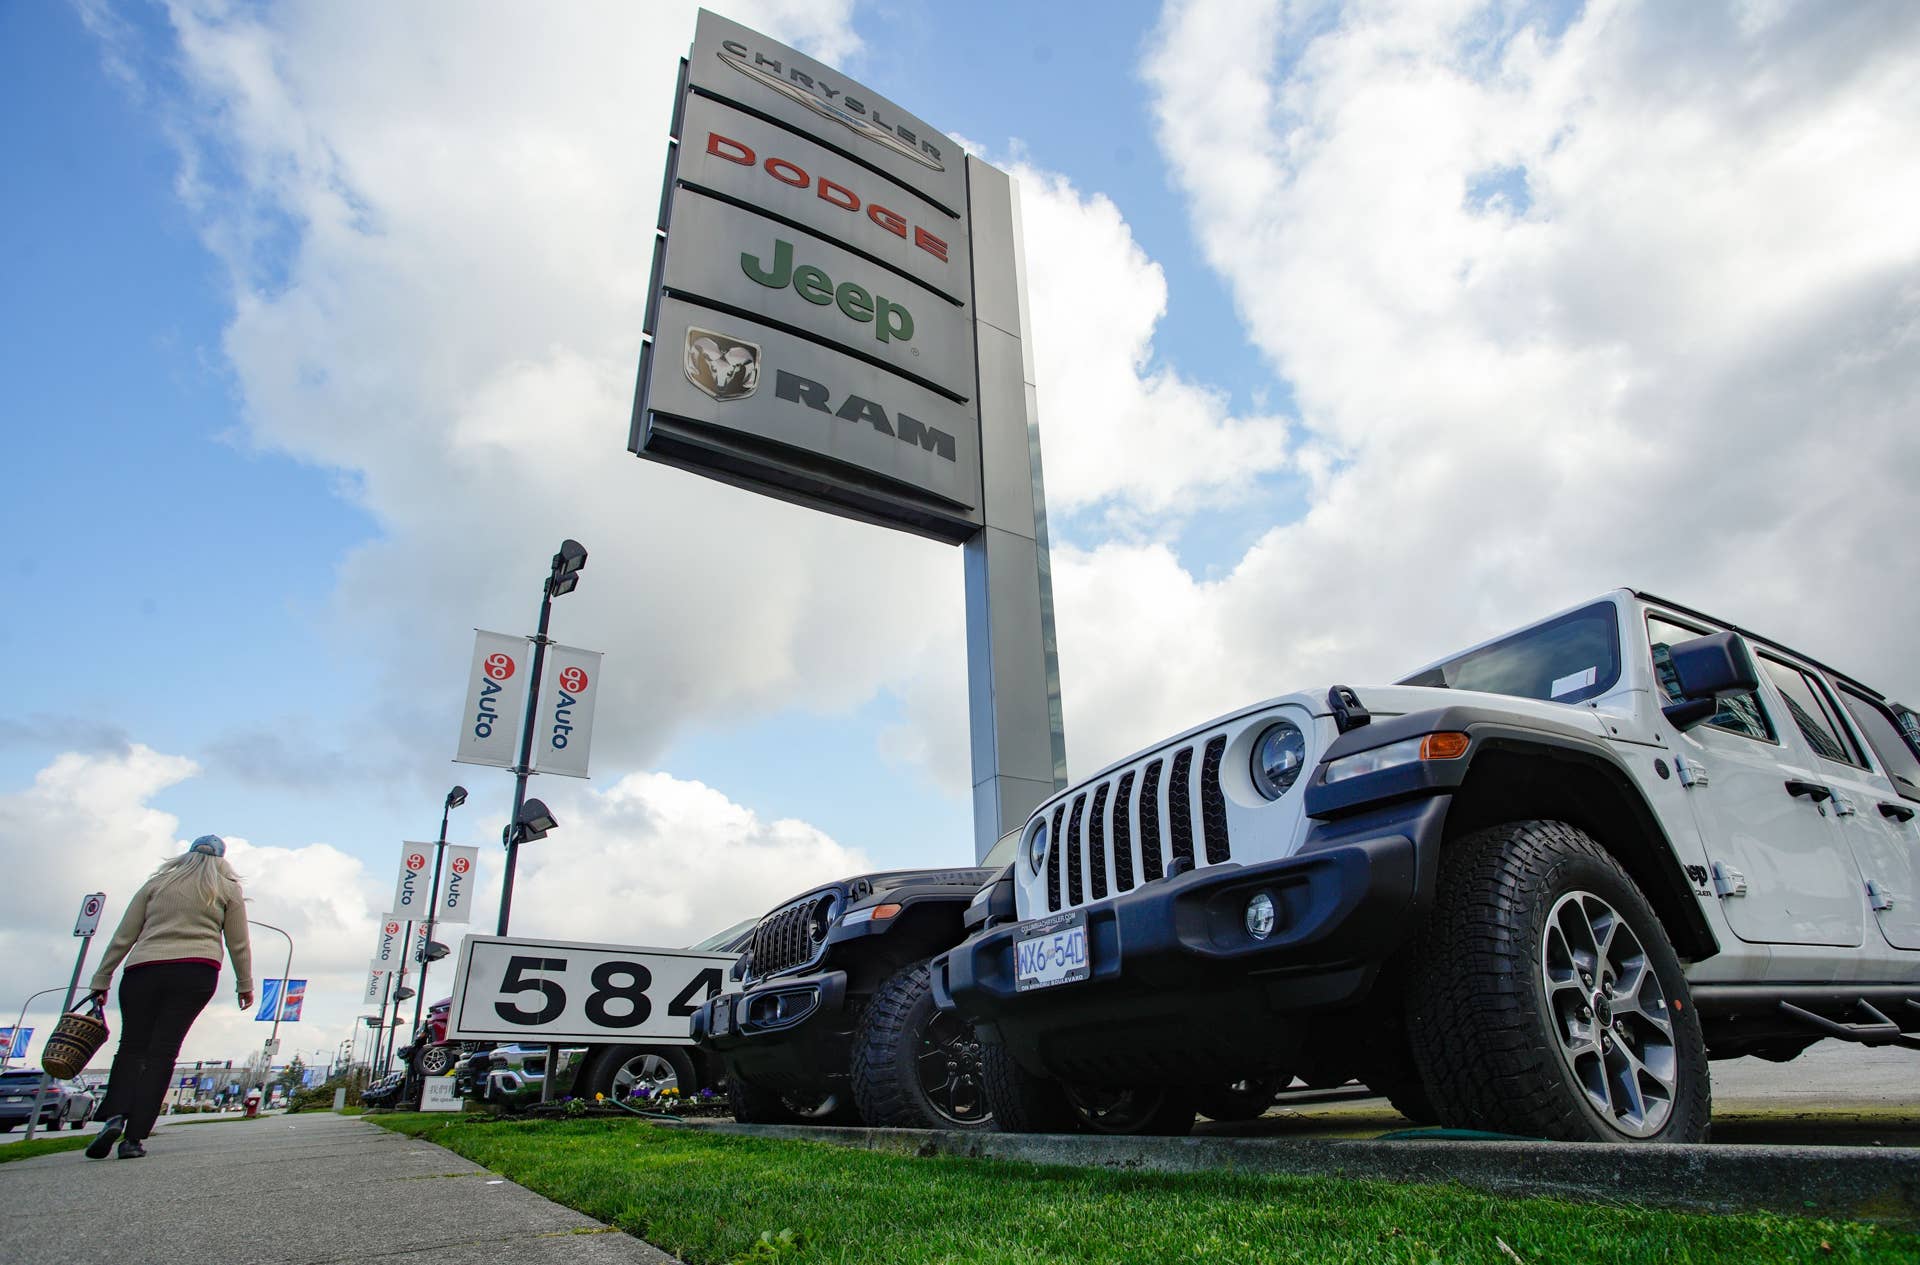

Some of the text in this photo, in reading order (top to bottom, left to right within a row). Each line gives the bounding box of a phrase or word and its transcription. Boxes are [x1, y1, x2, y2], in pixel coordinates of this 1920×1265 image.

[722, 39, 942, 162] CHRYSLER
[706, 131, 948, 263] DODGE
[741, 239, 914, 344] Jeep
[775, 369, 956, 462] RAM
